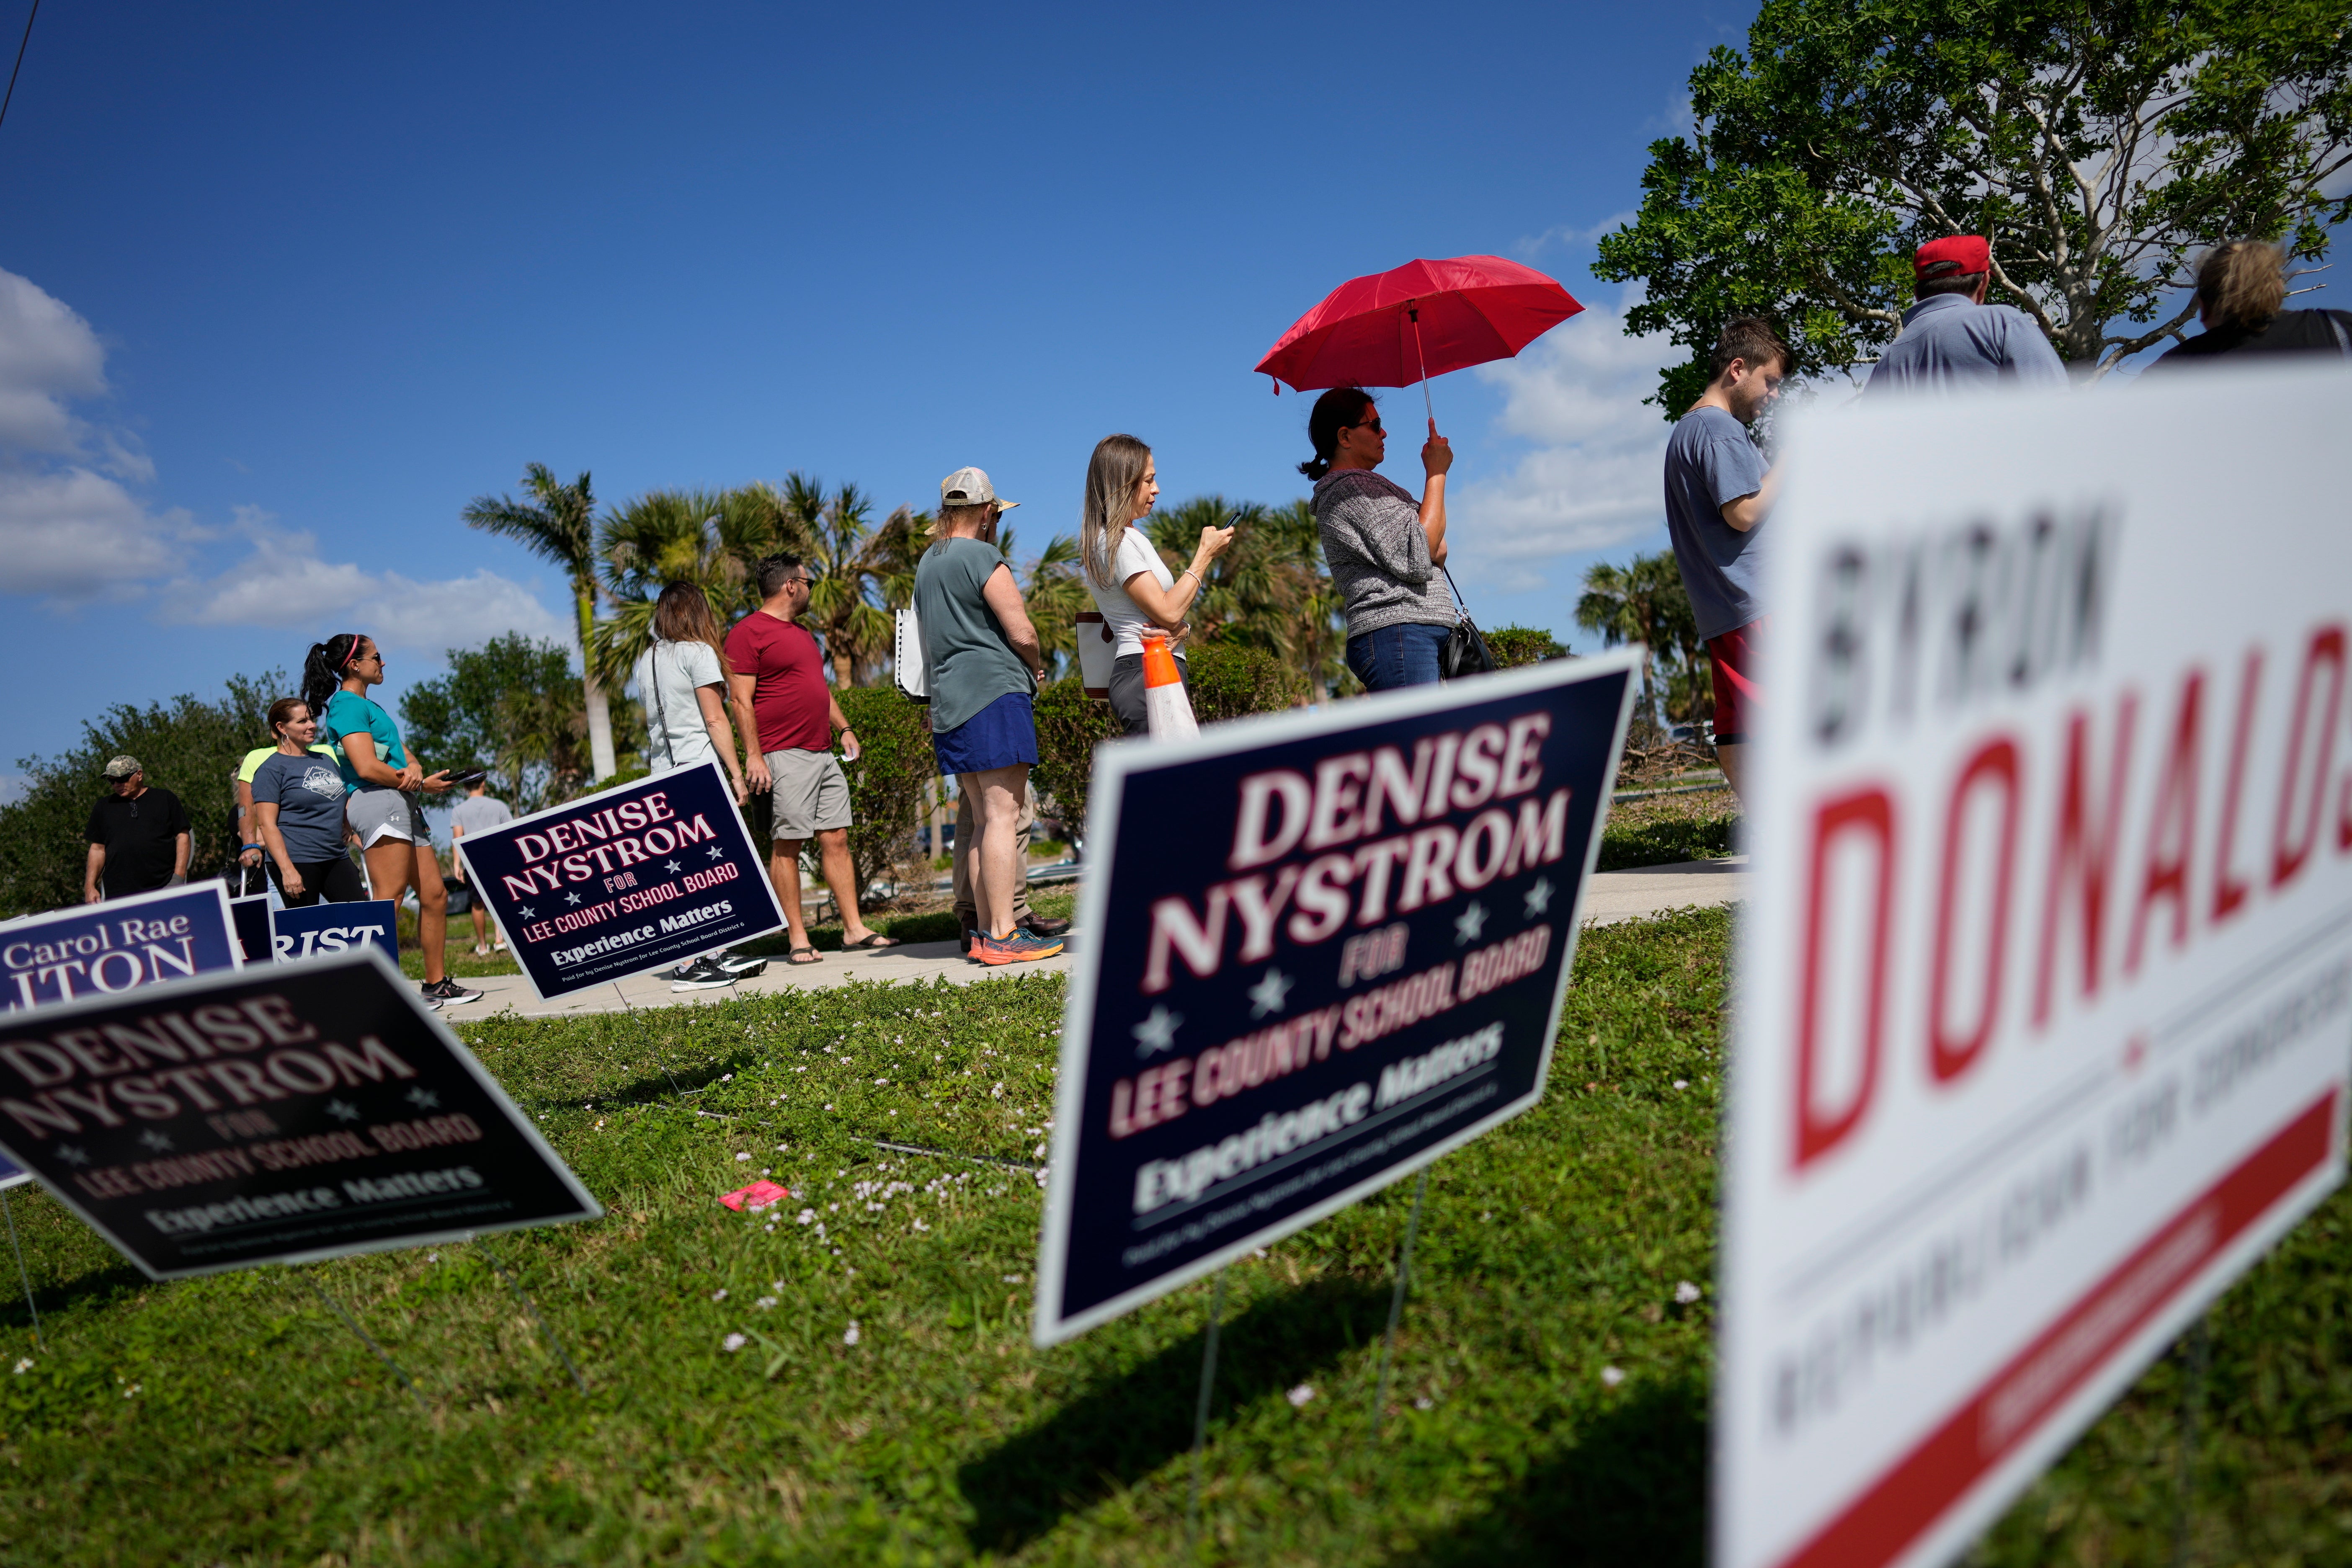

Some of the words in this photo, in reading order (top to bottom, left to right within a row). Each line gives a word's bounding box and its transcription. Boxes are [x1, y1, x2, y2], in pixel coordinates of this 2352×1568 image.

[1811, 494, 2125, 748] BYRON
[514, 791, 675, 864] DENISE
[1227, 711, 1553, 870] DENISE
[501, 813, 717, 901] NYSTROM
[603, 872, 638, 893] FOR
[1141, 789, 1571, 994] NYSTROM
[523, 921, 556, 943] LEE
[554, 900, 617, 933] COUNTY
[619, 882, 684, 913] SCHOOL
[683, 862, 739, 893] BOARD
[550, 925, 656, 966] Experience
[659, 900, 733, 934] Matters
[1788, 621, 2352, 1176] DONALD
[3, 924, 114, 970] Carol
[118, 914, 191, 946] Rae
[8, 935, 197, 1016] ITON
[593, 964, 614, 973] Denise
[613, 956, 639, 967] Nystrom
[659, 943, 681, 953] County
[680, 936, 700, 946] School
[700, 930, 718, 940] Board
[718, 924, 740, 934] District
[985, 941, 1004, 953] HOKA
[1339, 922, 1410, 987] FOR
[0, 993, 318, 1088] DENISE
[1108, 1057, 1193, 1139] LEE
[1191, 1004, 1341, 1108] COUNTY
[1339, 960, 1458, 1050] SCHOOL
[1457, 923, 1553, 1003] BOARD
[0, 1035, 418, 1140] NYSTROM
[205, 1109, 281, 1142] FOR
[1132, 1081, 1373, 1214] Experience
[1373, 1021, 1506, 1111] Matters
[74, 1166, 143, 1200] LEE
[132, 1147, 255, 1191] COUNTY
[250, 1130, 378, 1172] SCHOOL
[368, 1112, 484, 1153] BOARD
[144, 1186, 343, 1233] Experience
[341, 1165, 484, 1205] Matters
